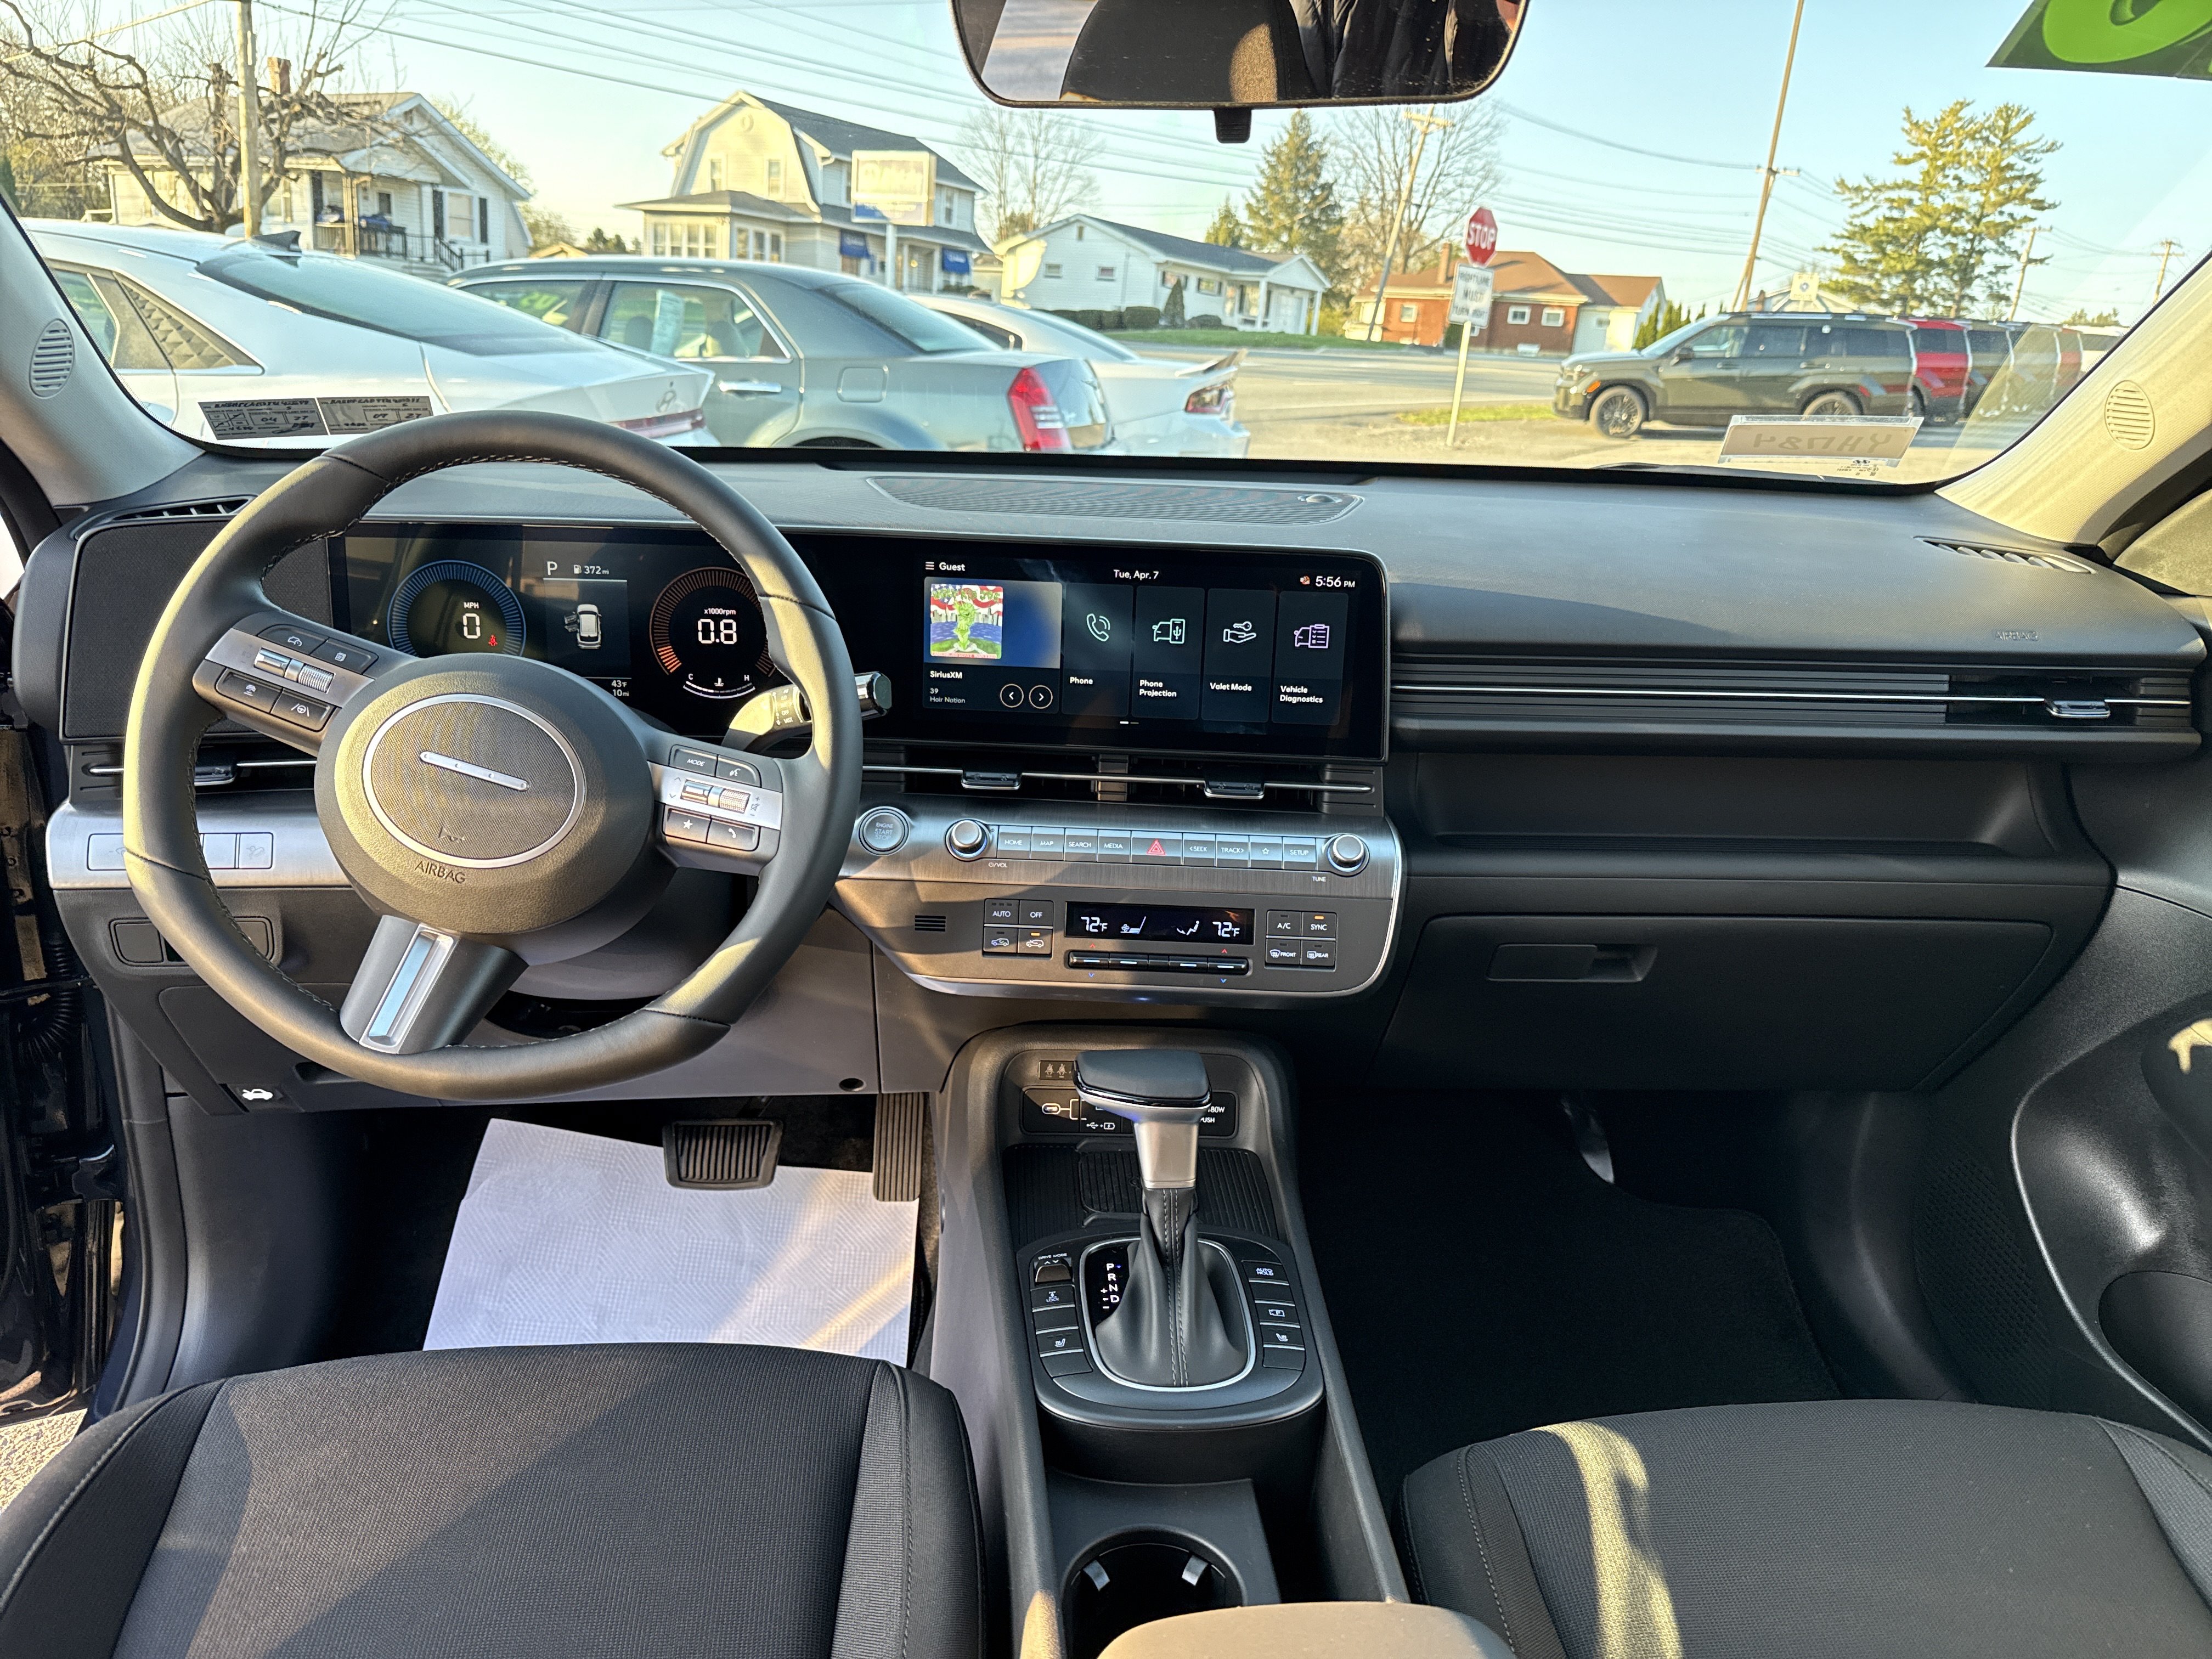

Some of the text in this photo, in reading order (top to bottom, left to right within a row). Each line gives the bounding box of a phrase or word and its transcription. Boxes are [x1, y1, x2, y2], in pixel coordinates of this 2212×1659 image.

[1468, 223, 1496, 250] STOP
[548, 561, 557, 575] P
[584, 566, 601, 574] 372
[939, 562, 966, 572] Guest
[1114, 569, 1159, 580] Tue, Apr. 7
[1315, 576, 1342, 588] 5:56
[704, 608, 736, 616] x1000rpm
[463, 613, 481, 639] 0
[698, 619, 737, 644] 0.8
[930, 671, 963, 679] SiriusXM
[1210, 682, 1230, 691] Valet
[1280, 686, 1308, 694] Vehicle
[1139, 689, 1177, 698] Projection
[1280, 695, 1323, 704] Diagnostics
[687, 759, 705, 767] MODE
[414, 861, 466, 884] AIRBAG
[1106, 1263, 1114, 1271] P
[1107, 1273, 1116, 1282] R
[1109, 1284, 1118, 1292] N
[1110, 1295, 1120, 1303] D
